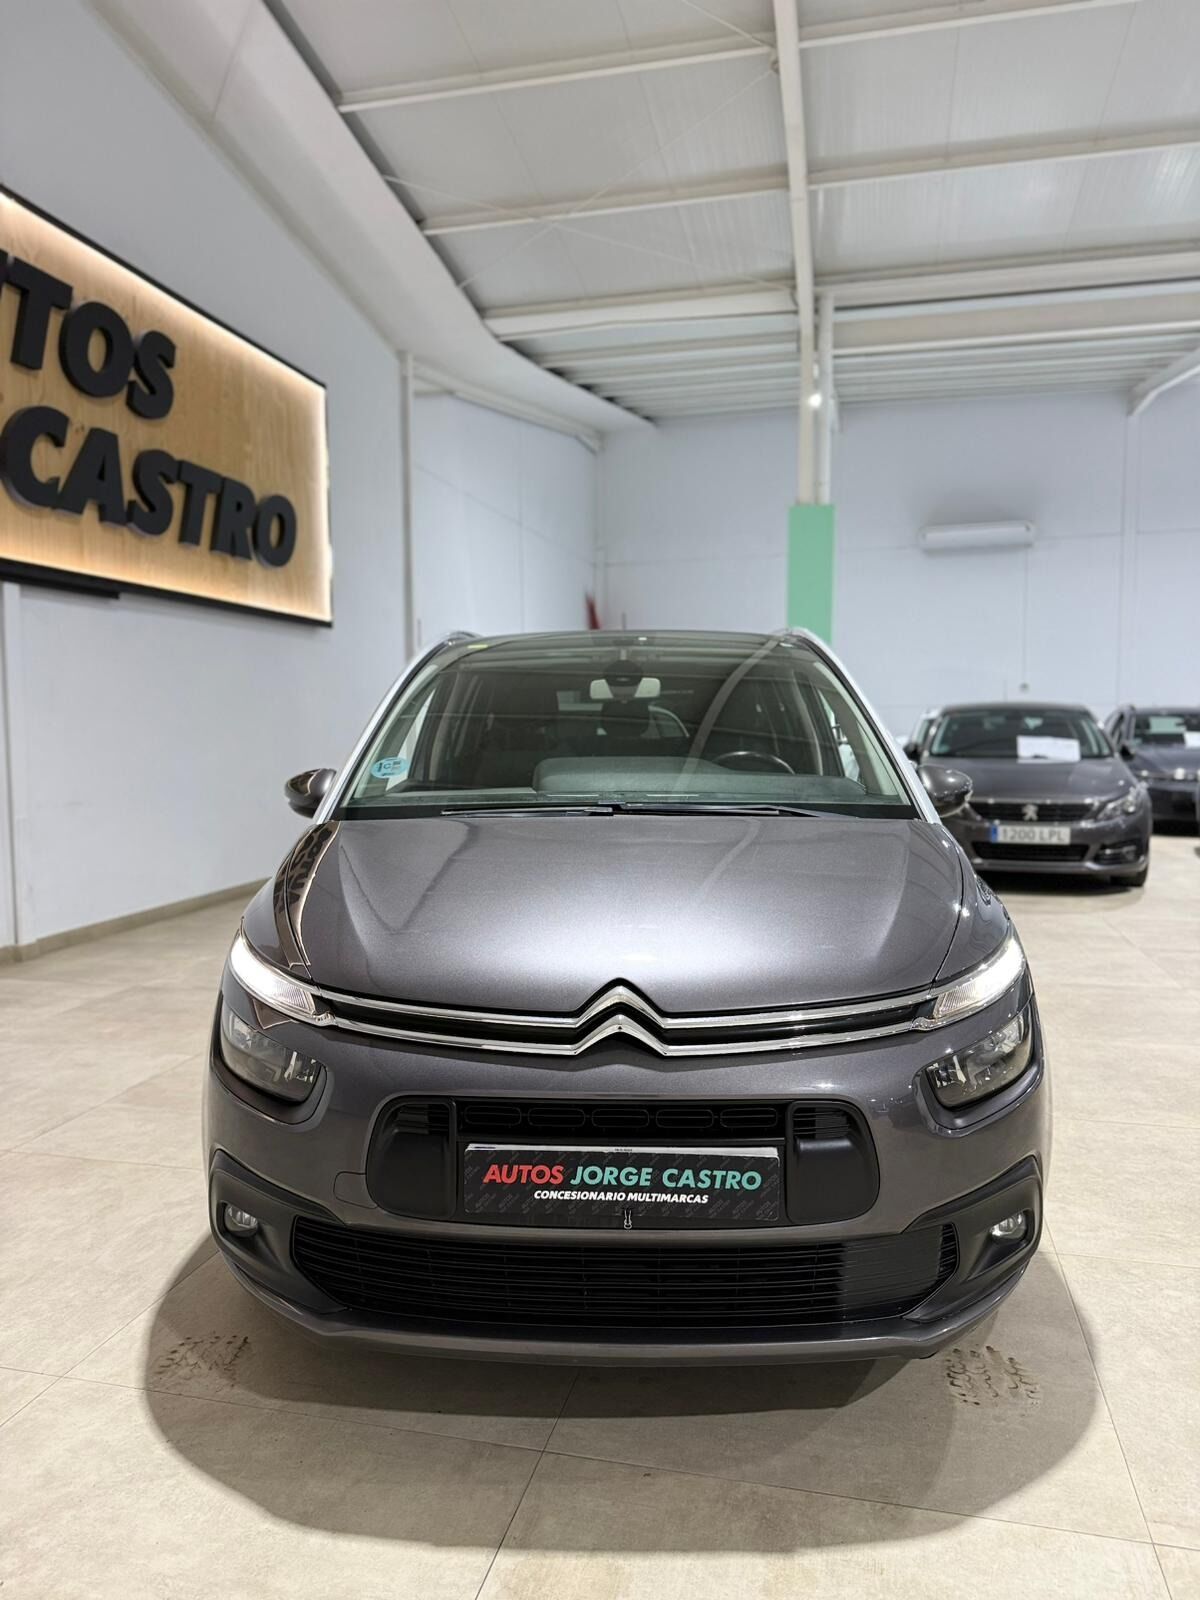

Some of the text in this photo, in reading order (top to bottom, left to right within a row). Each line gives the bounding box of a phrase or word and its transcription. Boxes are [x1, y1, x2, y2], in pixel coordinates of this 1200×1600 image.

[0, 250, 176, 419] TOS
[0, 406, 297, 567] CASTRO
[1002, 828, 1036, 842] 1200
[483, 1164, 762, 1190] AUTOS JORGE CASTRO
[534, 1190, 626, 1202] CONCESIONARIO
[627, 1192, 709, 1204] MULTIMARCAS
